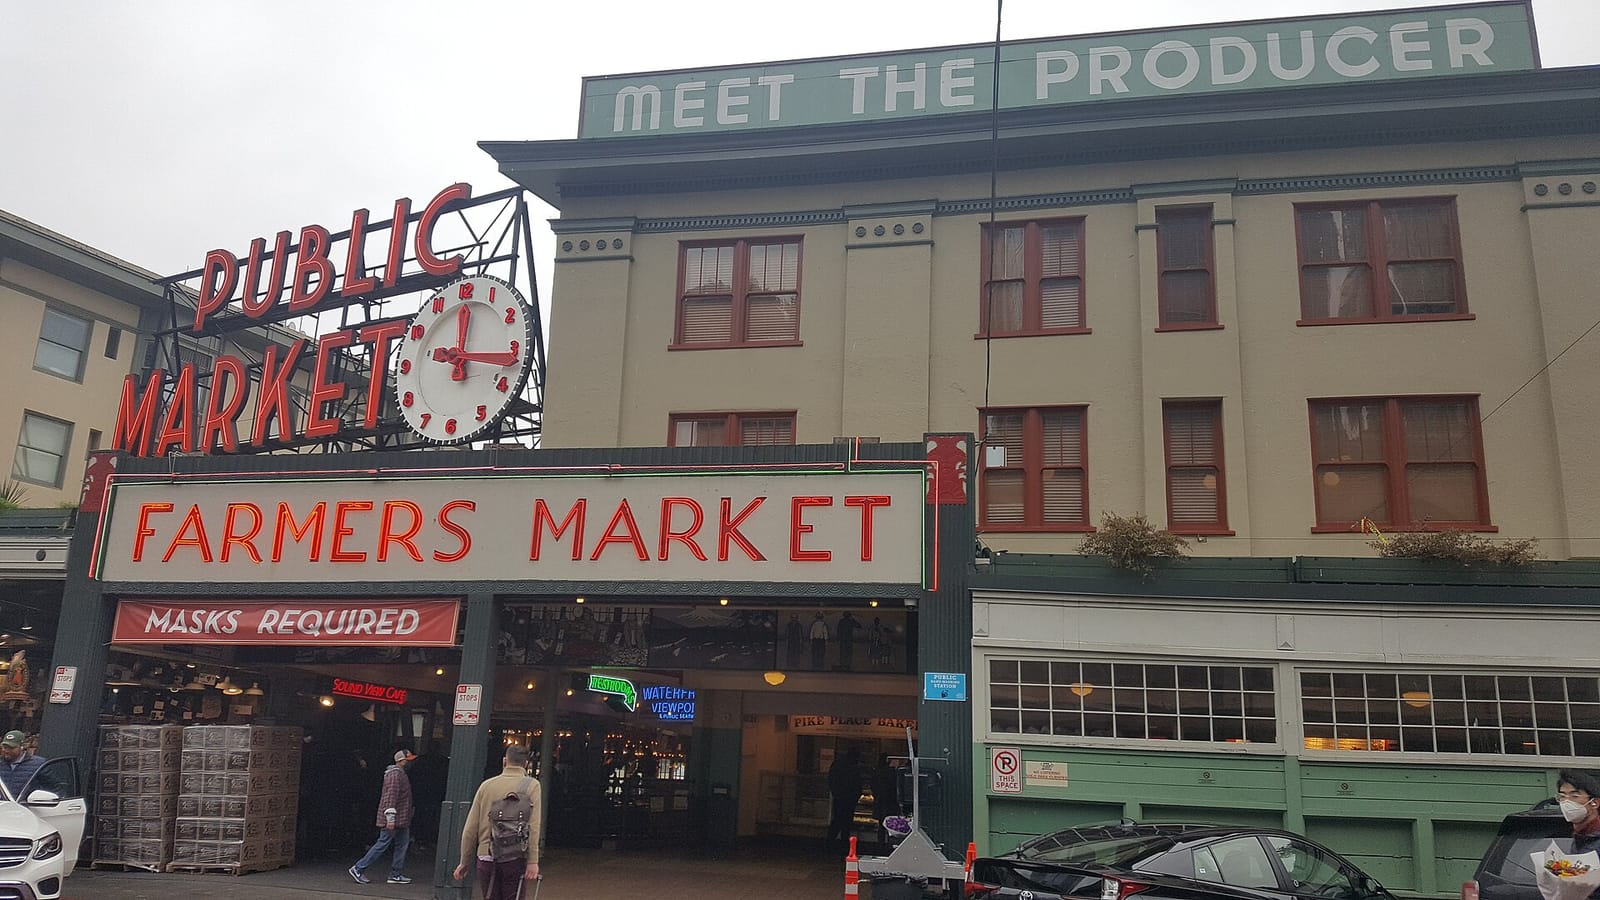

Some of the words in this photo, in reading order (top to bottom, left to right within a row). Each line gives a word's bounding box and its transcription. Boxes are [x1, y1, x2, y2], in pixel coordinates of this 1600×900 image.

[613, 74, 794, 132] MEET
[839, 58, 975, 115] THE
[1036, 17, 1495, 100] PRODUCER
[193, 182, 472, 332] PUBLIC
[459, 283, 474, 300] 12
[489, 287, 496, 303] 1
[433, 297, 445, 313] 11
[505, 307, 516, 324] 2
[411, 324, 425, 341] 10
[510, 340, 519, 356] 3
[400, 359, 411, 375] 9
[111, 318, 407, 457] MARKET
[496, 376, 508, 392] 4
[402, 391, 414, 407] 8
[420, 413, 431, 429] 7
[475, 405, 487, 421] 5
[445, 419, 457, 434] 6
[132, 500, 476, 563] FARMERS
[529, 496, 891, 562] MARKET
[144, 609, 242, 633] MASKS
[257, 608, 420, 636] REQUIRED
[332, 678, 363, 693] SOUND
[364, 683, 385, 697] VIEW
[794, 716, 825, 728] PIKE
[830, 716, 871, 726] PLACE
